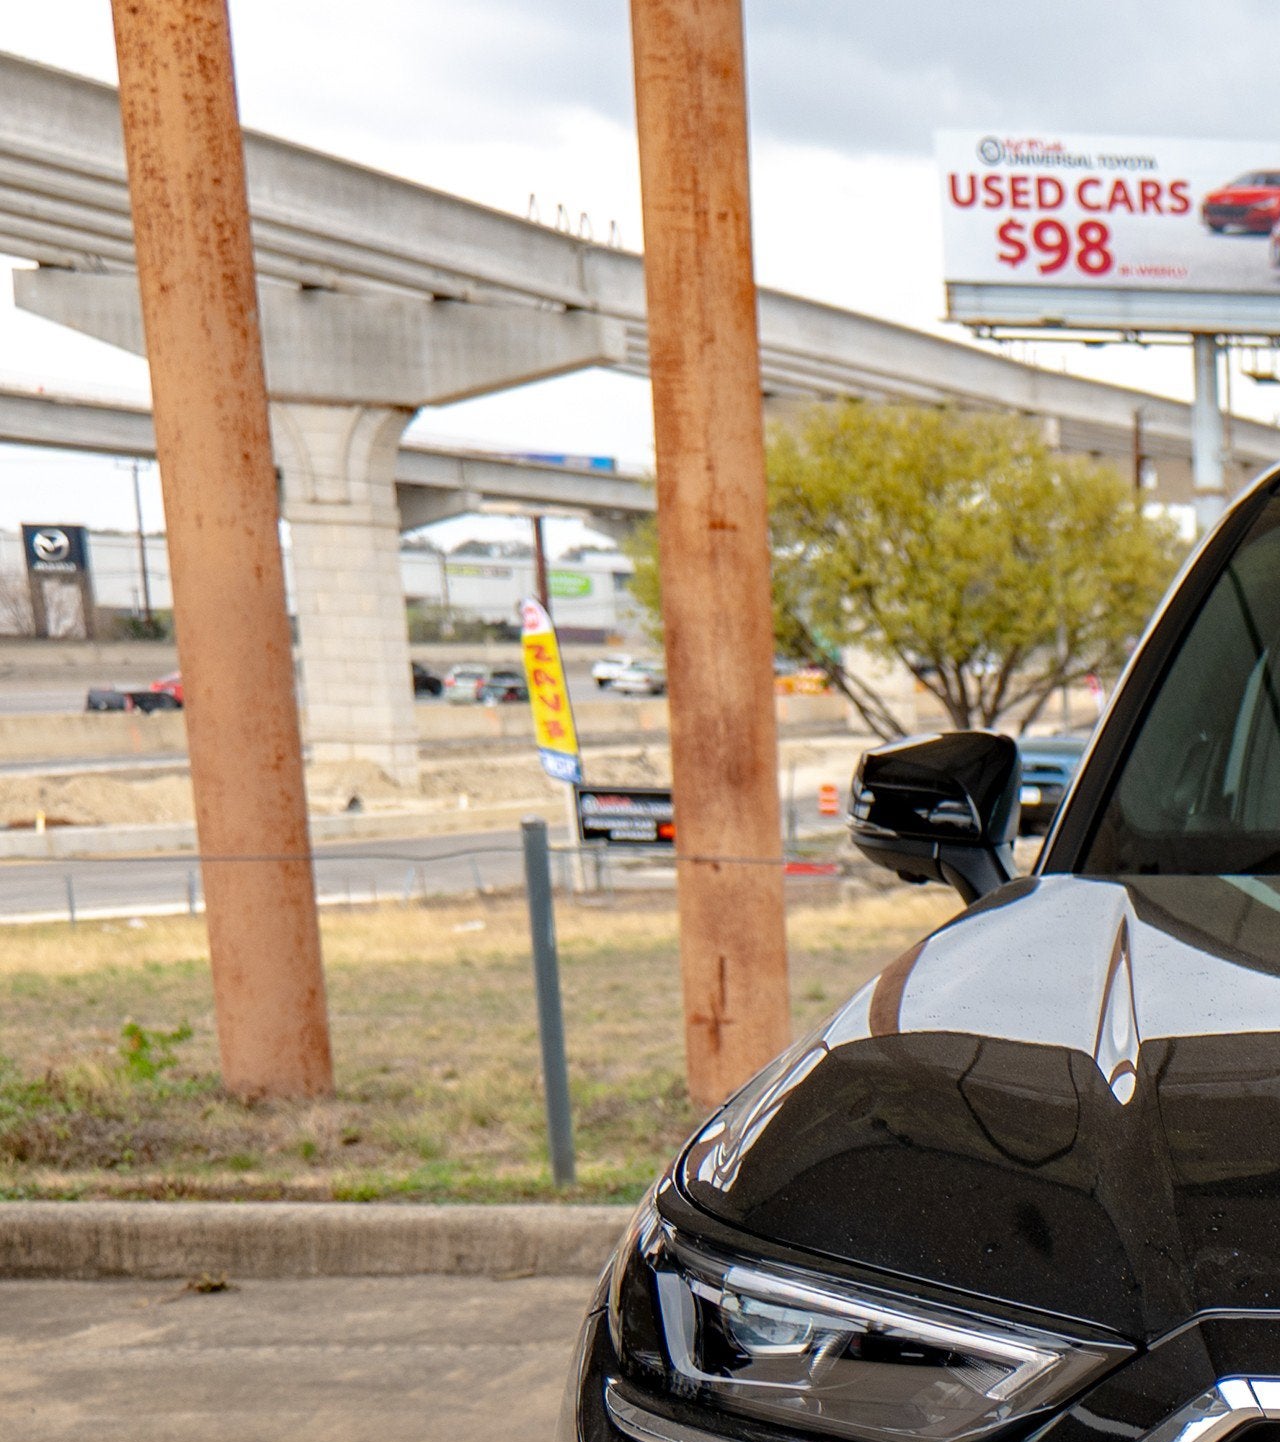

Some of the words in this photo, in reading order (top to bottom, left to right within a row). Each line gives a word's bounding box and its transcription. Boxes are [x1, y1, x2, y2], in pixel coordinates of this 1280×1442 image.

[949, 173, 1064, 209] USED
[1076, 178, 1190, 214] CARS
[997, 218, 1113, 276] $98
